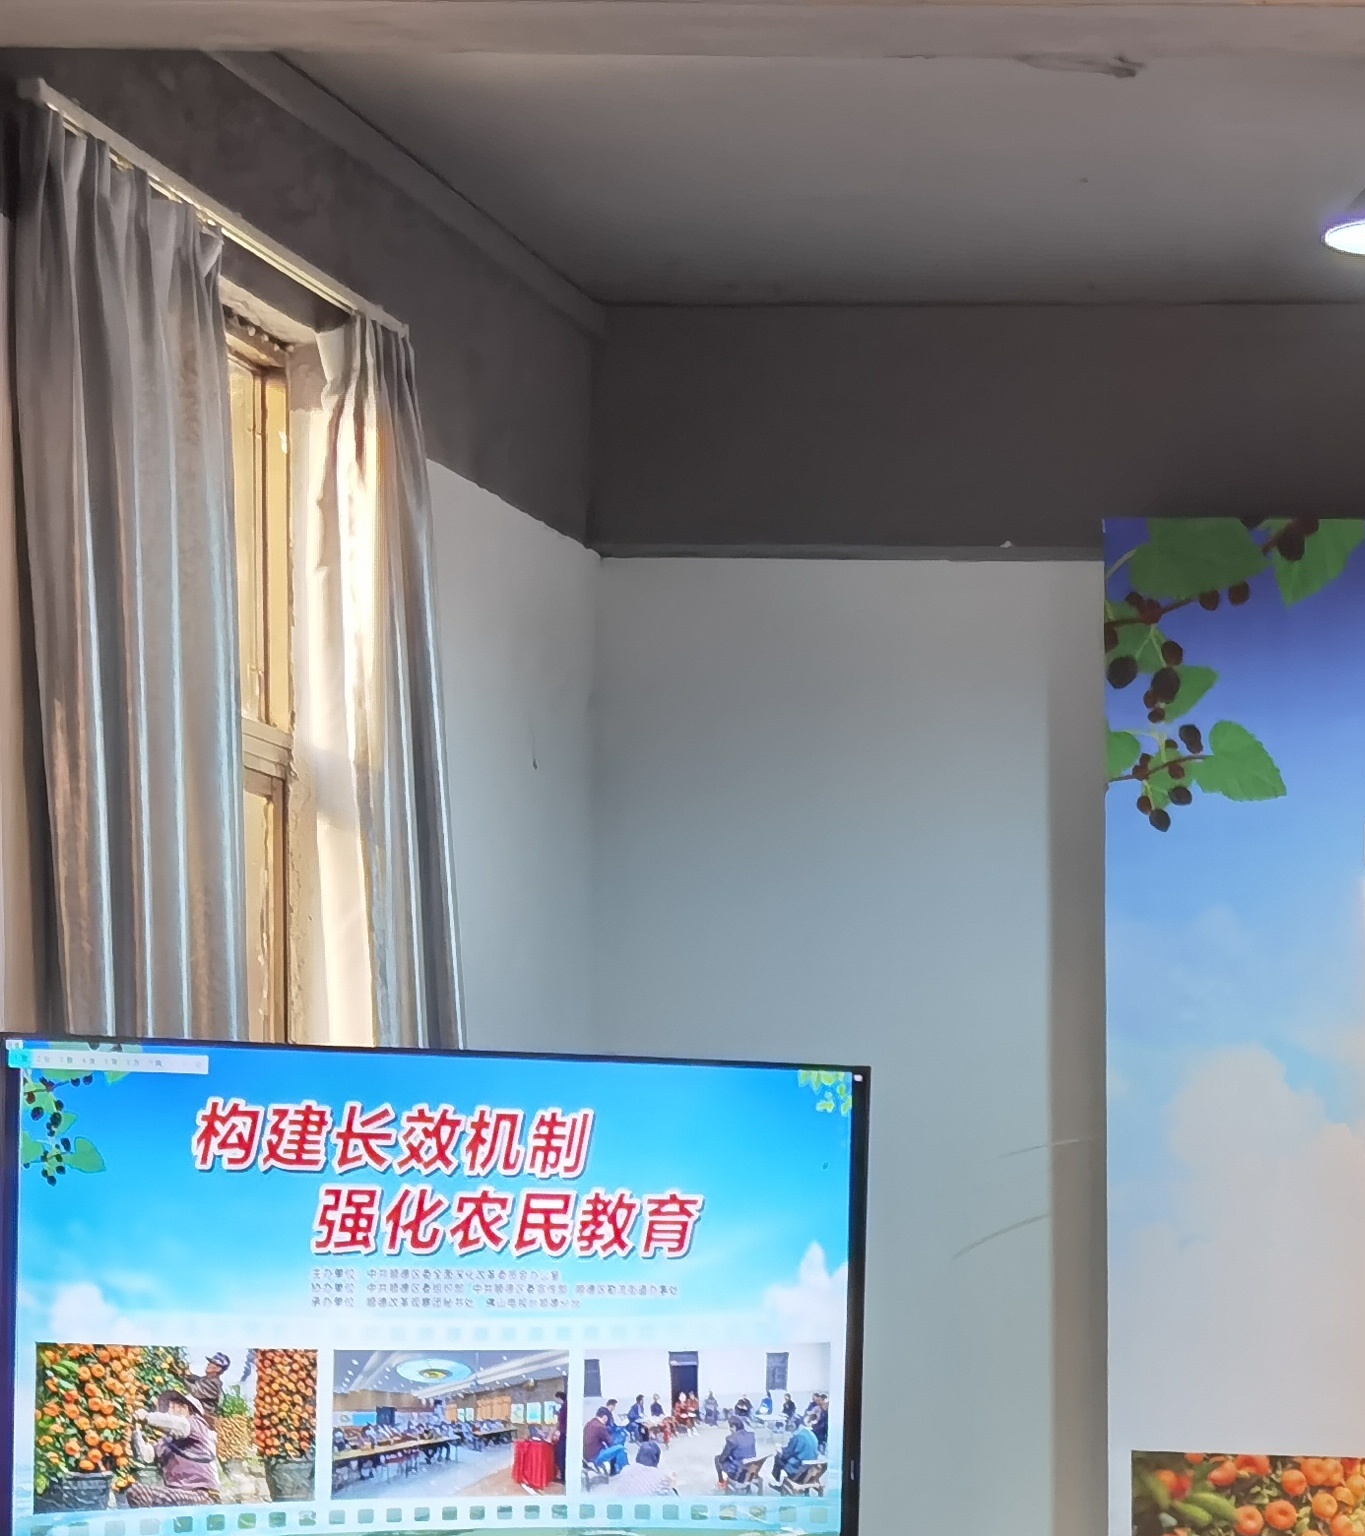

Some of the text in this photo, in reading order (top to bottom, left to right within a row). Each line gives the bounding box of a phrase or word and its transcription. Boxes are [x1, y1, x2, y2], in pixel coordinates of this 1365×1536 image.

[192, 1097, 596, 1179] 构建长效机制
[311, 1184, 704, 1260] 强化农民教育
